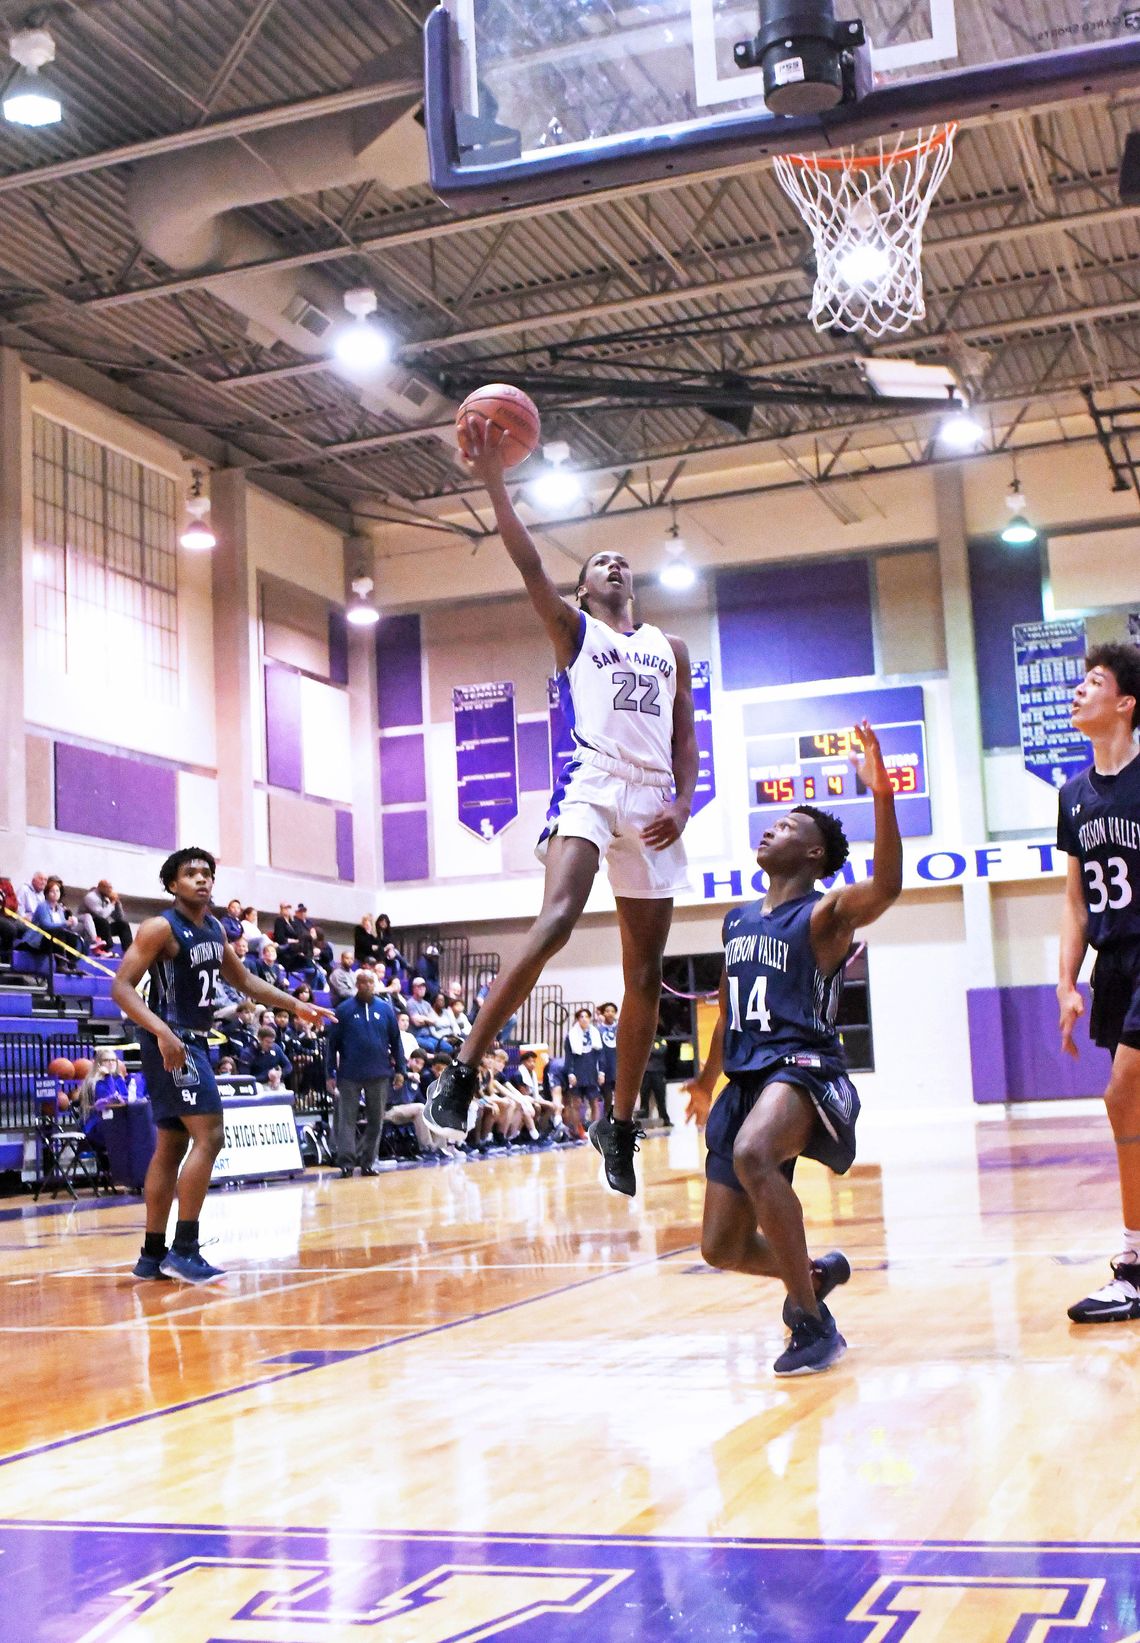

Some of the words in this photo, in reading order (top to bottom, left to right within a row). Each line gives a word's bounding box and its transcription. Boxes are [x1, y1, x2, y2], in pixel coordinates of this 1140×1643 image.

[591, 648, 621, 670] SAN
[612, 671, 661, 717] 22
[814, 731, 865, 757] 4:34
[763, 778, 795, 801] 45
[828, 776, 843, 795] 4
[886, 767, 915, 791] 53
[916, 848, 1002, 881] OF
[1084, 856, 1133, 914] 33
[758, 935, 789, 973] VALLEY
[198, 969, 221, 1008] 25
[728, 976, 772, 1032] 14
[233, 1125, 257, 1148] HIGH
[259, 1122, 294, 1146] SCHOOL
